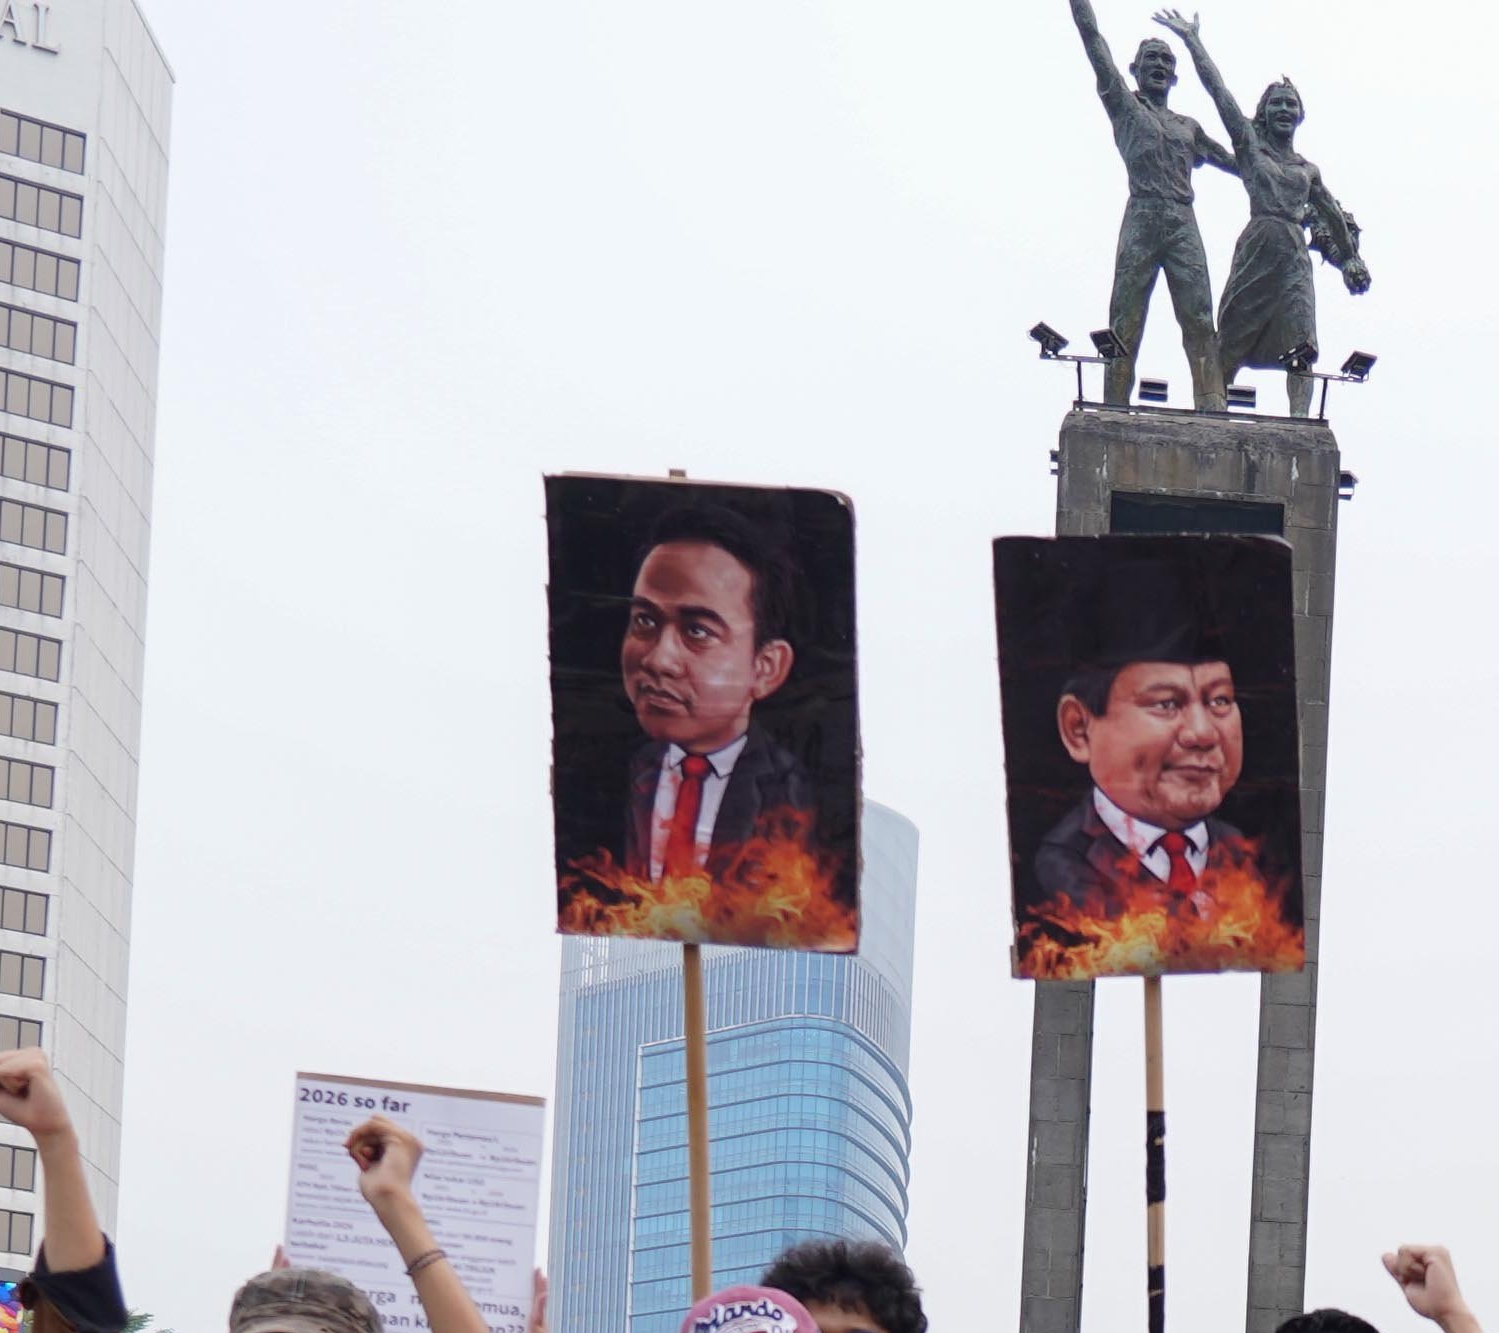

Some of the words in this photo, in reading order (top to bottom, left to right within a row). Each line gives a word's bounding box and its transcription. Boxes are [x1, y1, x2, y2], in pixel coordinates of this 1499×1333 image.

[300, 1087, 348, 1107] 2026
[354, 1096, 376, 1109] so
[382, 1095, 411, 1113] far
